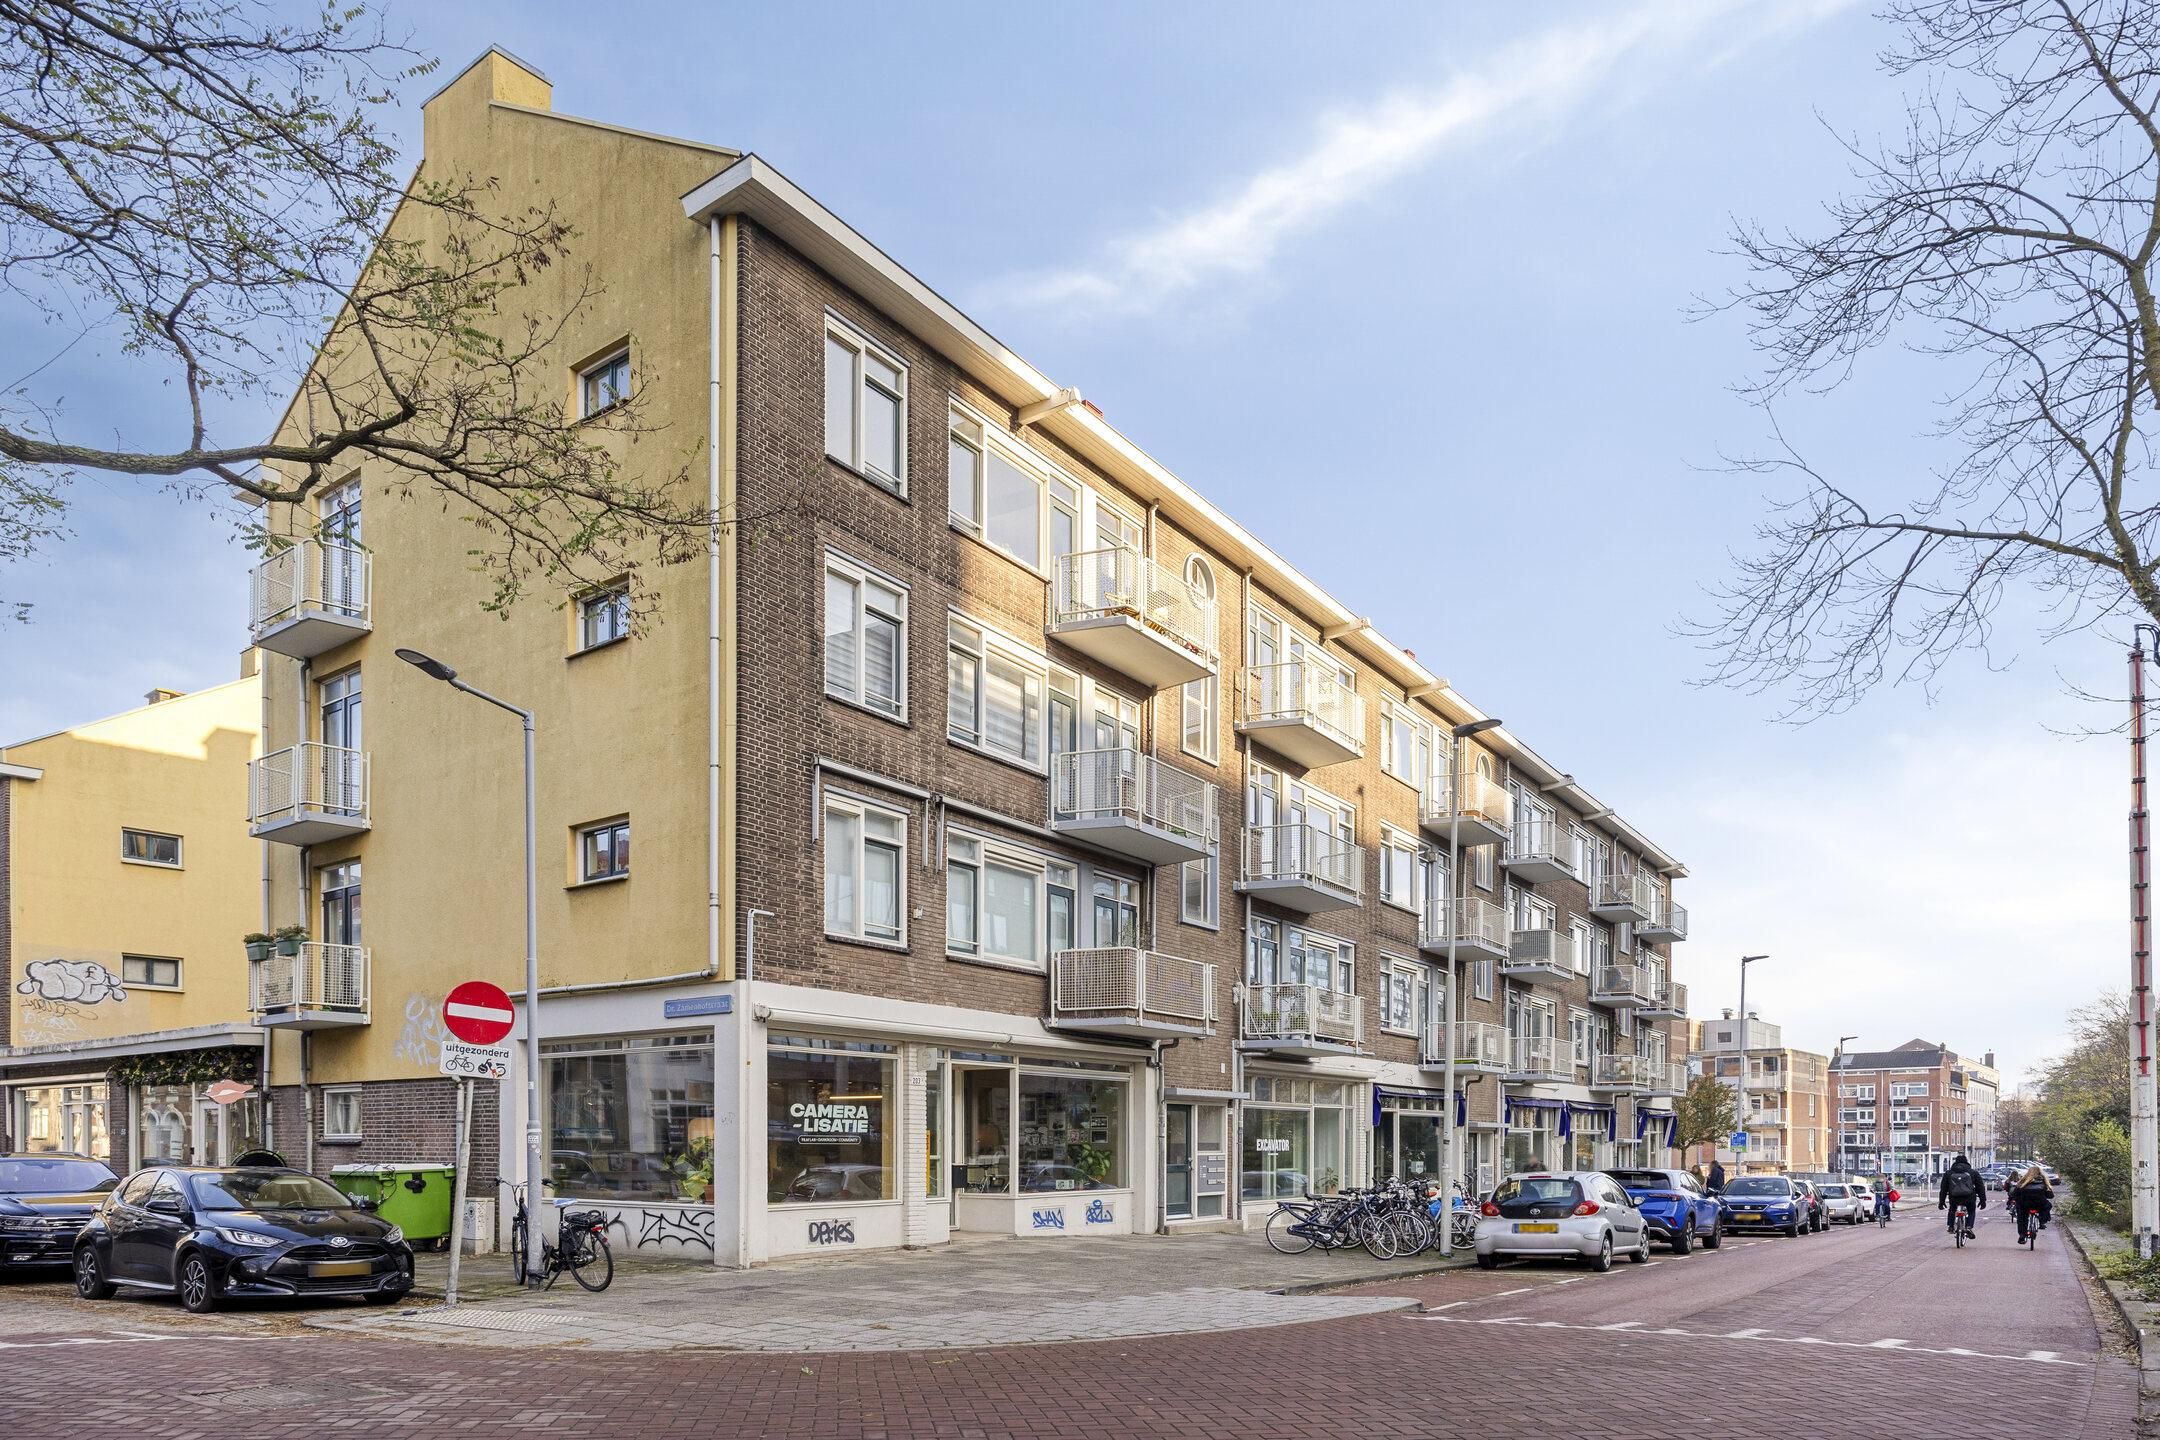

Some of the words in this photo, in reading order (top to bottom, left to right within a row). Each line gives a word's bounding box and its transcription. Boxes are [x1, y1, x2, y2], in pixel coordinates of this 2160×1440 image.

[666, 1004, 676, 1012] Dr.
[445, 1043, 509, 1058] uitgezonderd
[790, 1103, 869, 1119] CAMERA
[1256, 1138, 1290, 1151] EXCAVATOR
